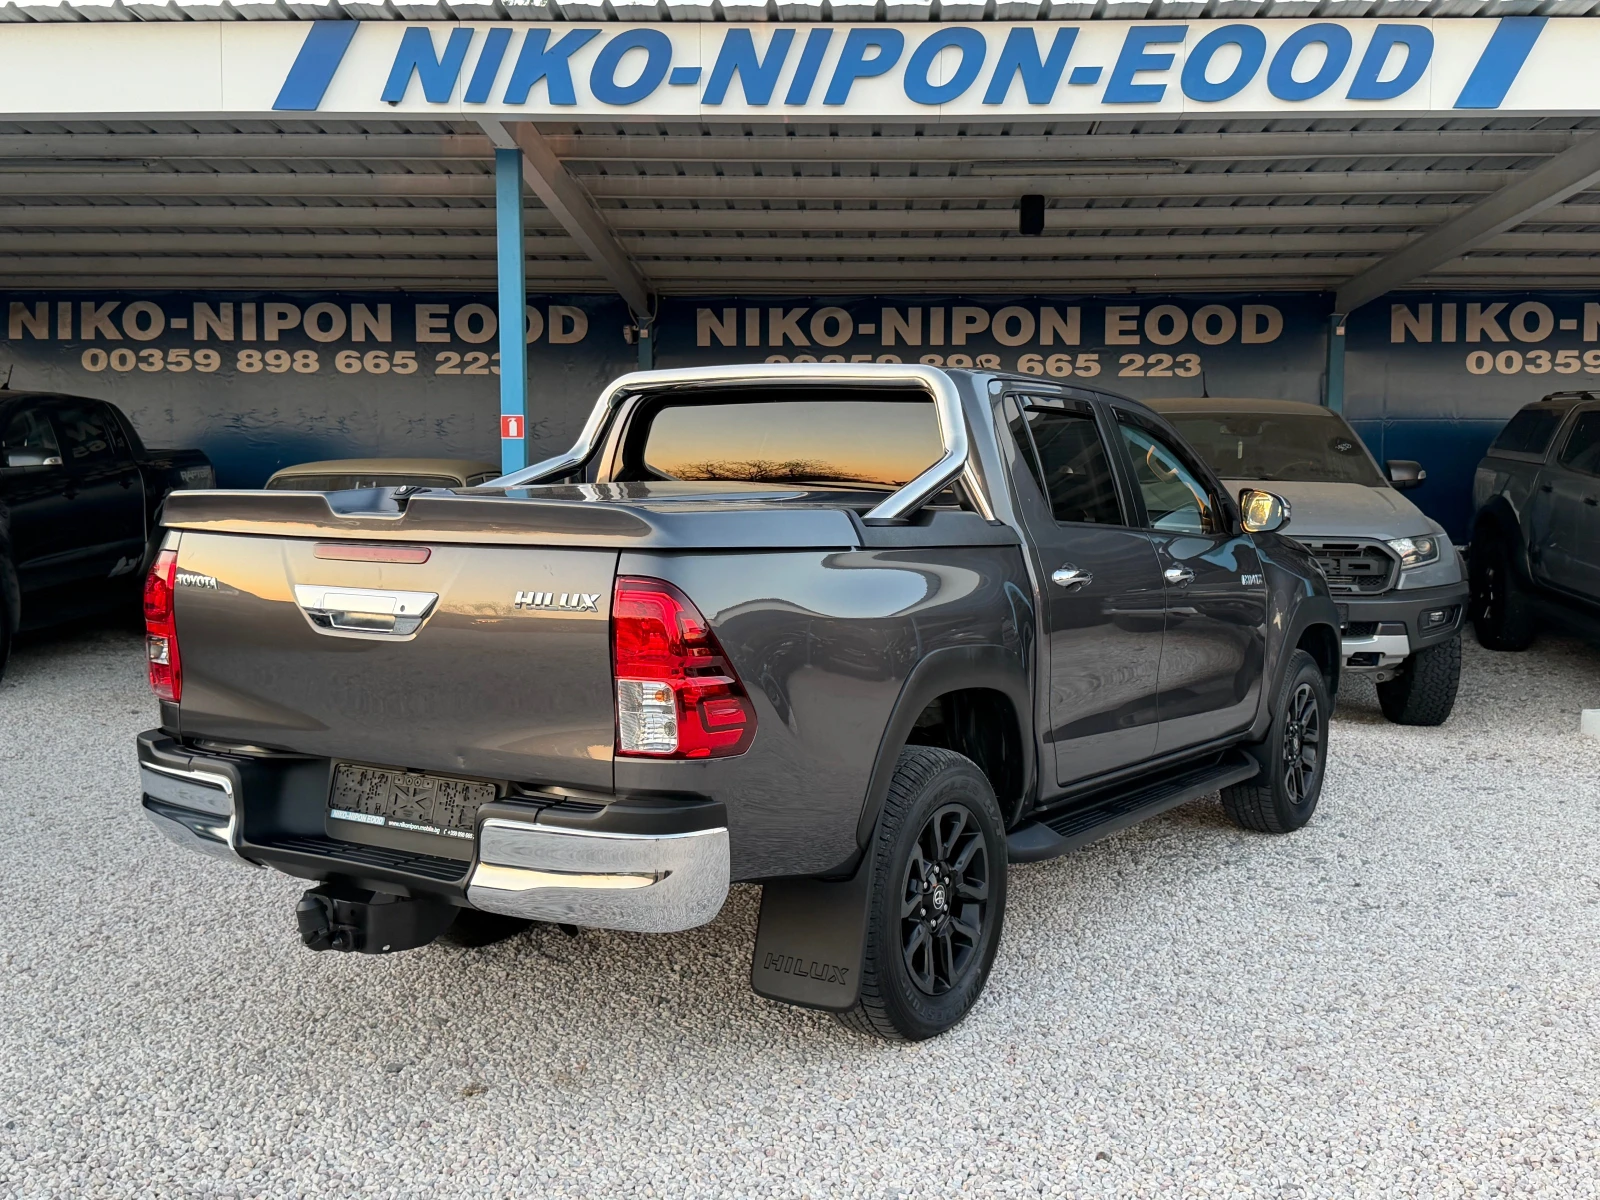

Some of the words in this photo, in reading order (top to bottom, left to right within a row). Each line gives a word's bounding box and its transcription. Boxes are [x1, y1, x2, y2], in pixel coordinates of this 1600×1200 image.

[380, 22, 1435, 106] NIKO-NIPON-EOOD
[8, 300, 392, 343] NIKO-NIPON
[696, 306, 1081, 347] NIKO-NIPON
[1104, 304, 1284, 346] EOOD
[81, 347, 222, 373] 00359
[236, 348, 320, 374] 898
[334, 350, 419, 375] 665
[434, 351, 501, 375] 22
[1016, 353, 1102, 377] 665
[1117, 353, 1202, 377] 223
[175, 573, 219, 590] TOYOTA
[514, 590, 602, 613] HILUX
[763, 952, 850, 985] HILUX
